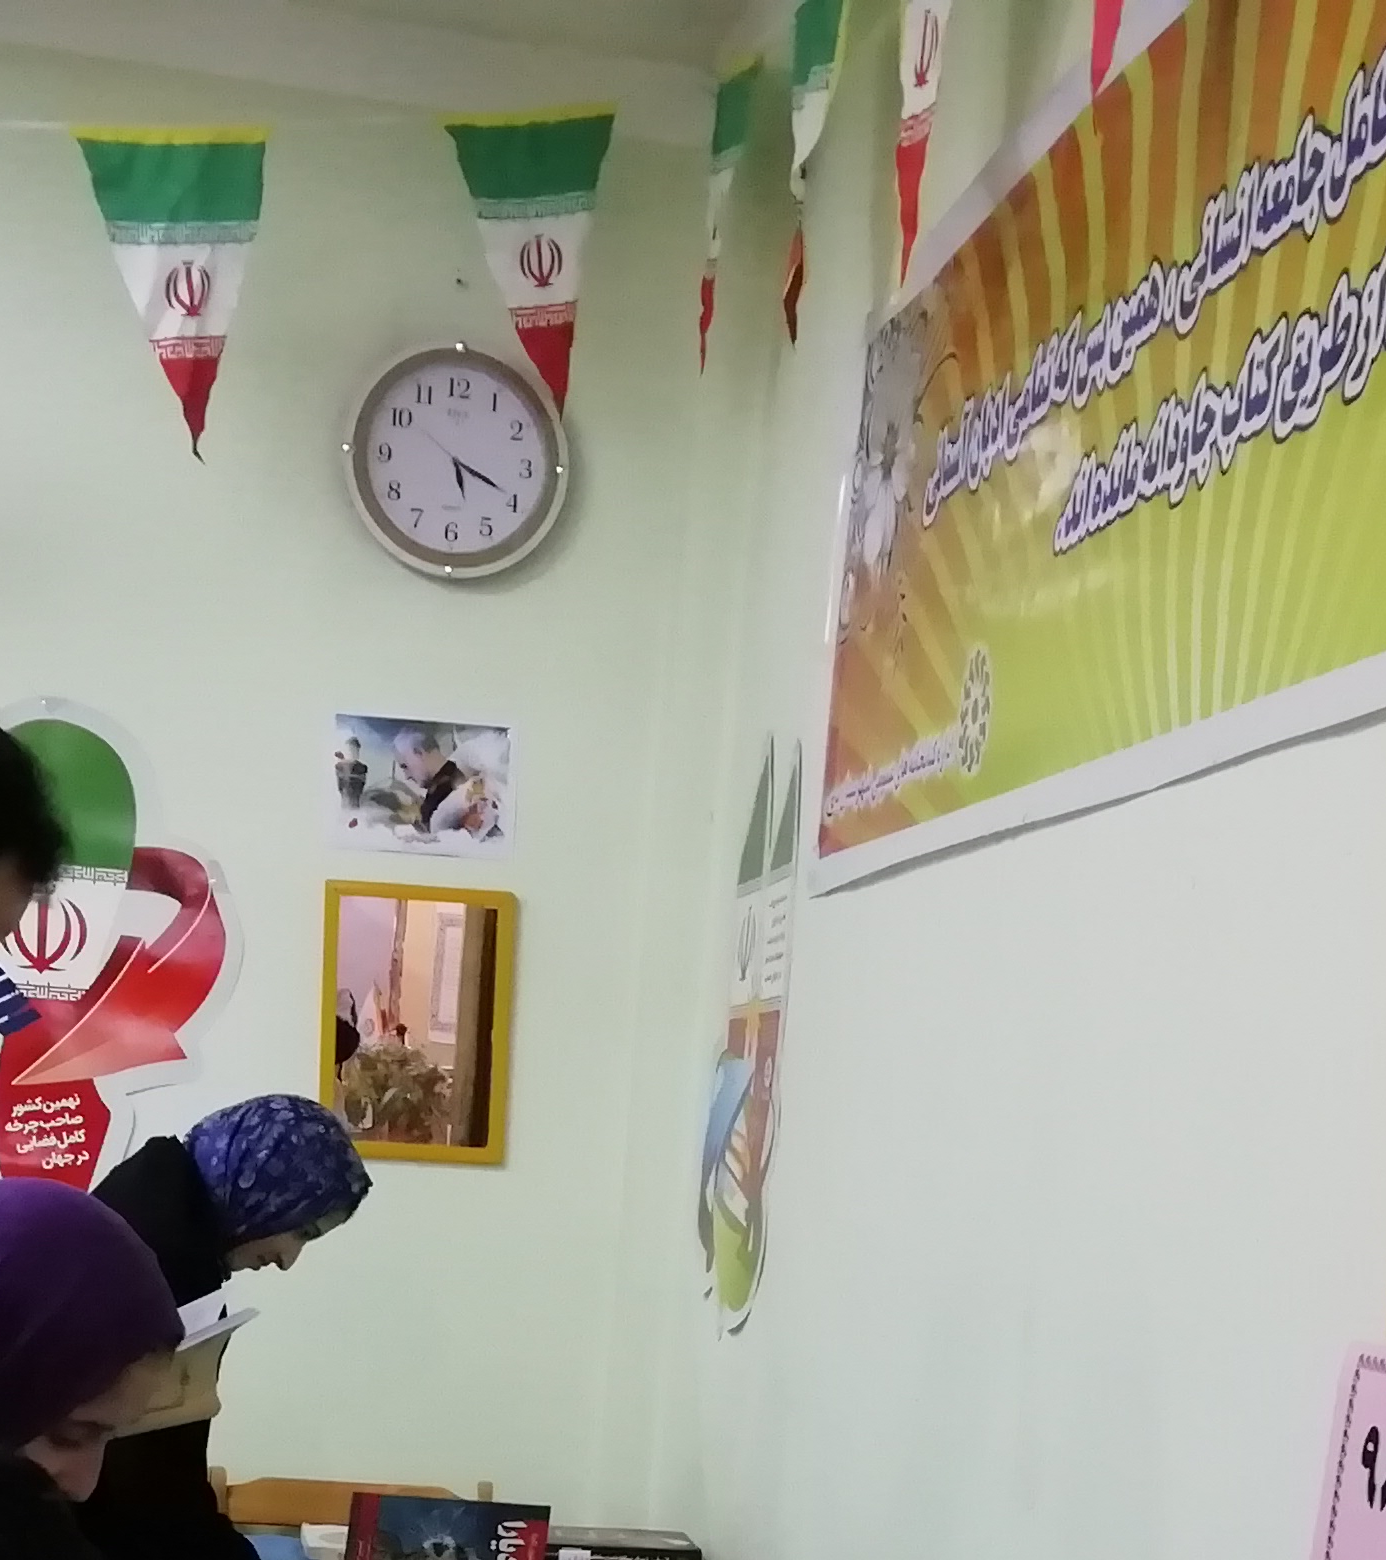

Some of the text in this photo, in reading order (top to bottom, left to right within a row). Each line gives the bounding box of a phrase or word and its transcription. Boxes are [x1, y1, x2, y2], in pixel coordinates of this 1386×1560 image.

[1249, 109, 1329, 242] جامعه
[1272, 268, 1357, 443] طریق
[414, 383, 433, 405] 11
[448, 377, 471, 399] 12
[1213, 311, 1288, 475] کتاب
[491, 391, 499, 412] 1
[390, 407, 413, 428] 10
[509, 420, 524, 441] 2
[1137, 368, 1219, 509] جاودانه
[378, 442, 392, 463] 9
[519, 458, 533, 479] 3
[387, 480, 401, 501] 8
[505, 493, 518, 514] 4
[410, 507, 424, 529] 7
[479, 516, 493, 537] 5
[444, 521, 458, 542] 6
[11, 1093, 81, 1117] نهمین کشور
[4, 1112, 84, 1134] صاحب چرخه
[16, 1128, 86, 1154] کامل فضایی
[41, 1150, 90, 1169] در جهان
